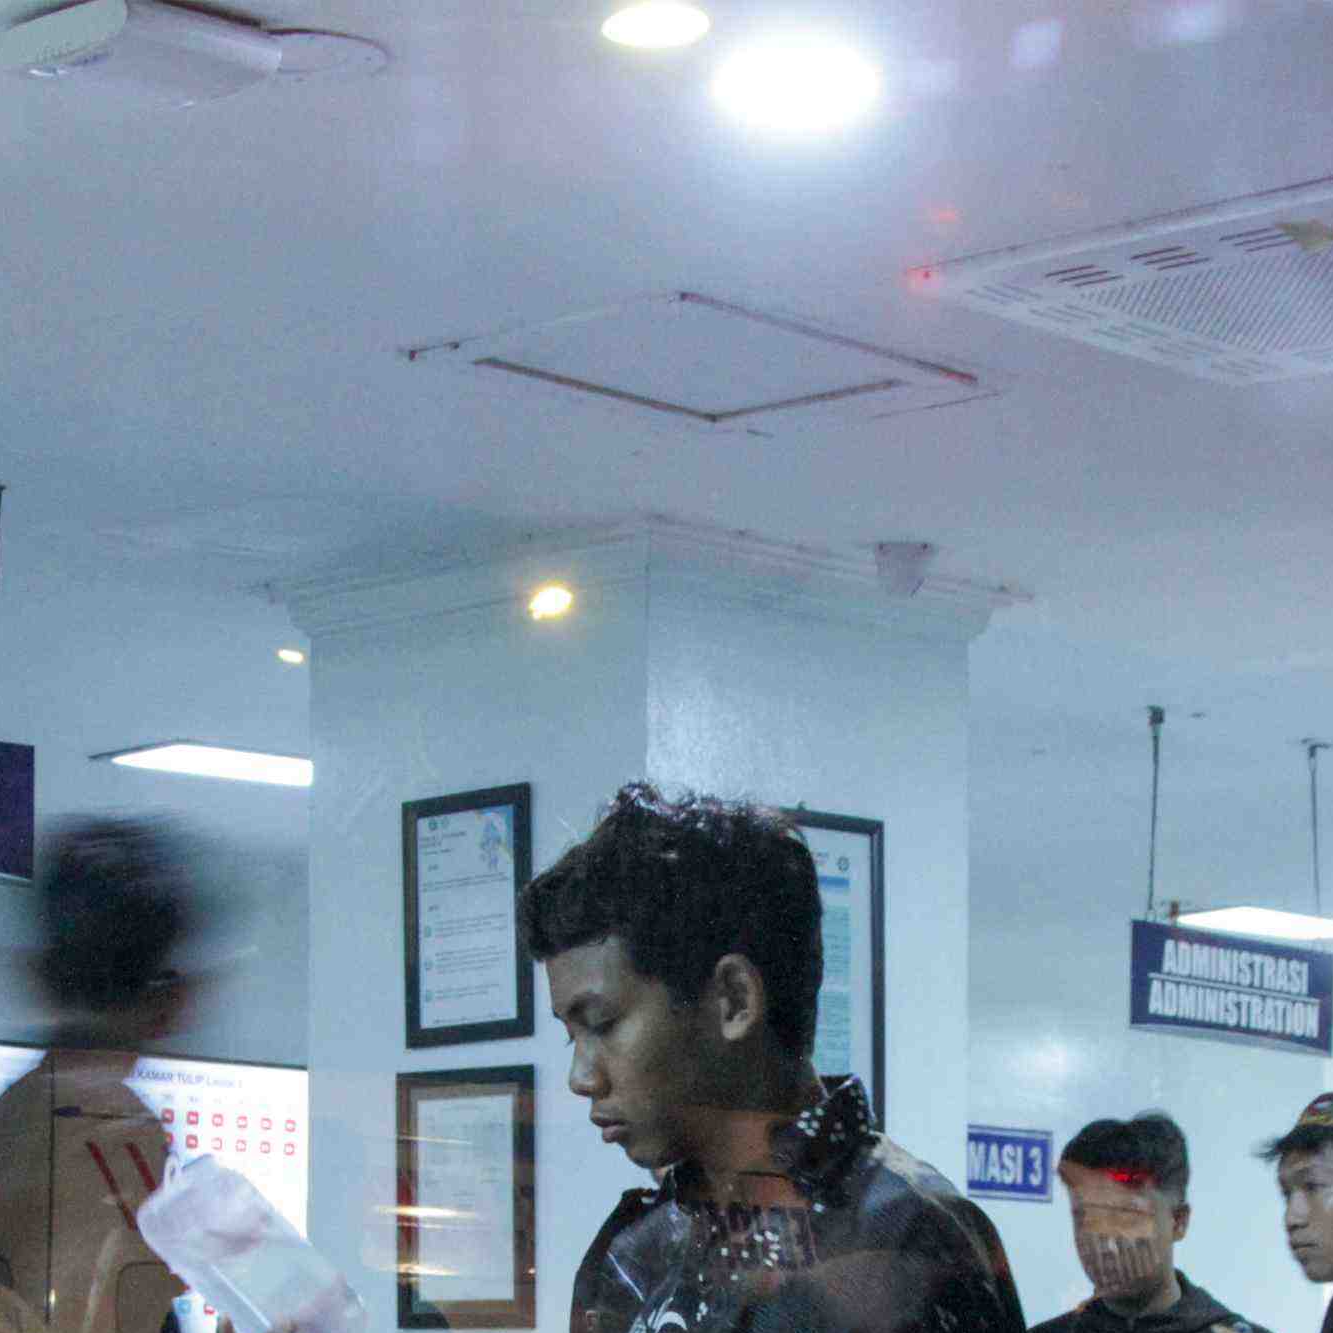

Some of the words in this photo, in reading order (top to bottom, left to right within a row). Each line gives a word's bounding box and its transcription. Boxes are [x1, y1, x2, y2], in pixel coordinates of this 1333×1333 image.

[1162, 939, 1309, 995] ADMINISTRASI
[1148, 979, 1320, 1038] ADMINISTRATION
[1028, 1146, 1044, 1187] 3
